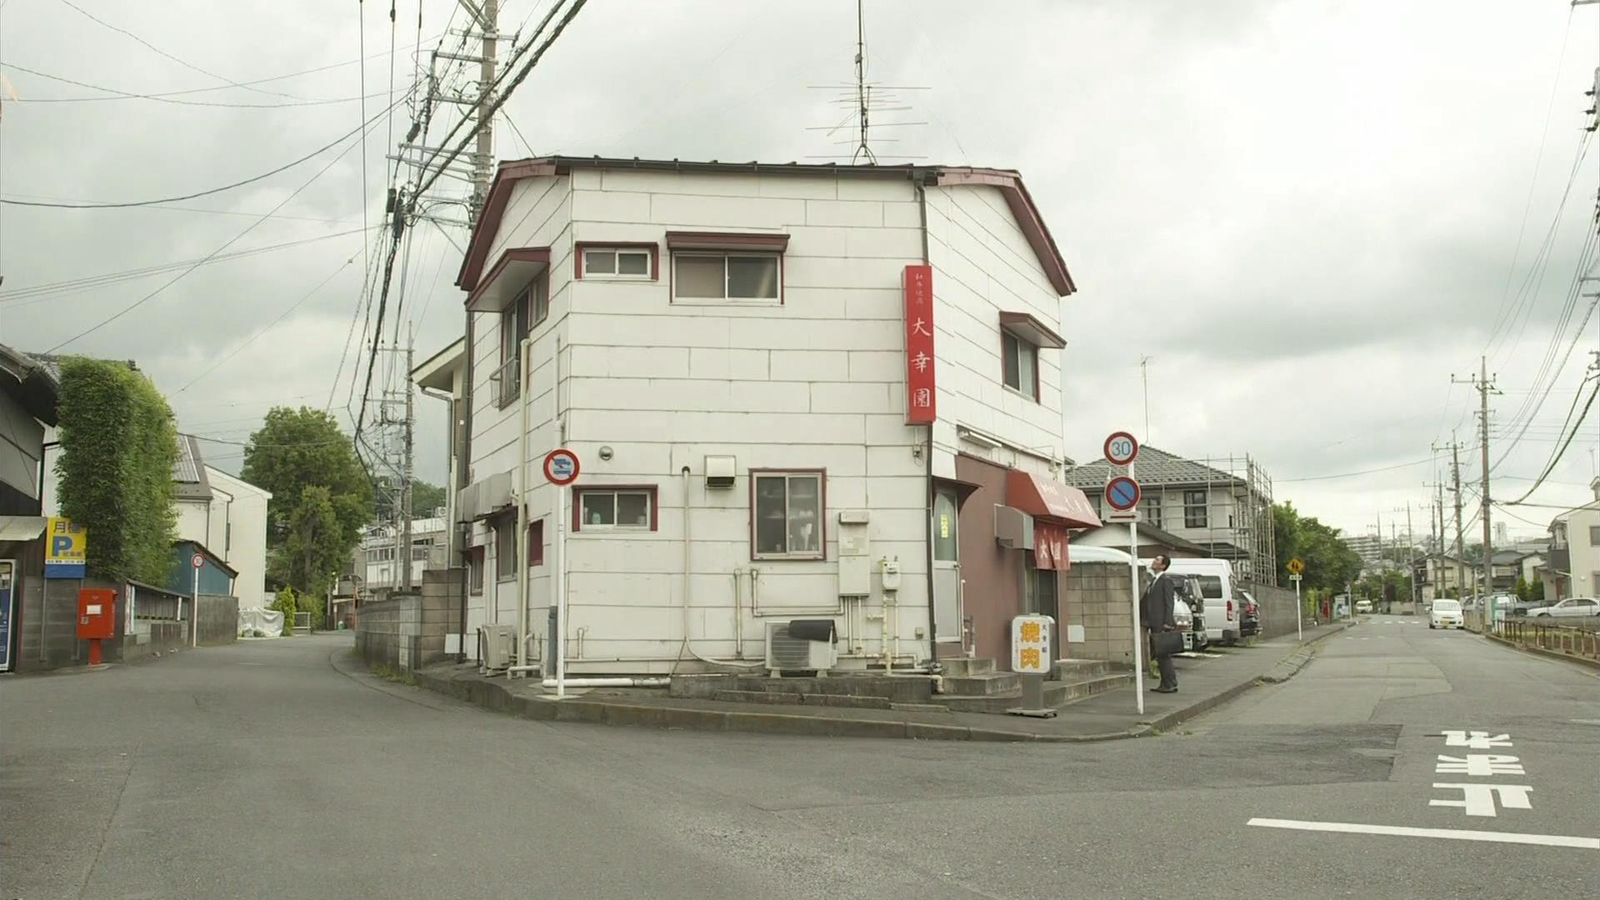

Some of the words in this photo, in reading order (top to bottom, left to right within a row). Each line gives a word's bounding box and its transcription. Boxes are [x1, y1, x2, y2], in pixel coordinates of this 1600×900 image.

[910, 317, 932, 408] 大幸園
[1111, 441, 1131, 456] 30
[52, 536, 73, 557] P
[1020, 621, 1040, 669] 焼肉
